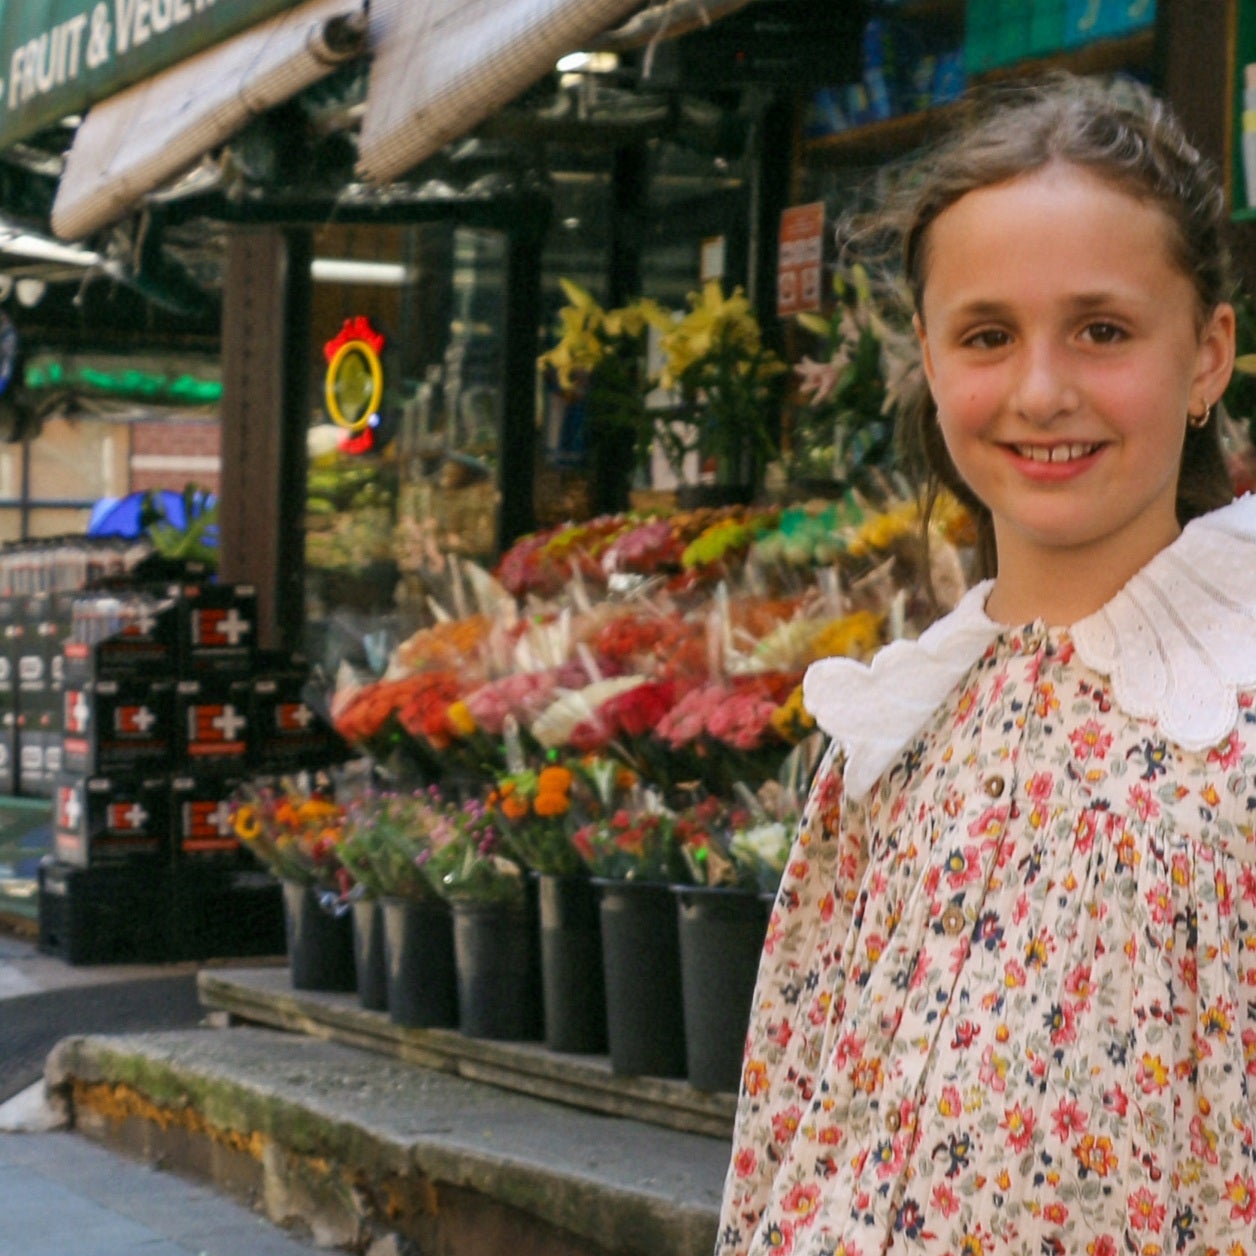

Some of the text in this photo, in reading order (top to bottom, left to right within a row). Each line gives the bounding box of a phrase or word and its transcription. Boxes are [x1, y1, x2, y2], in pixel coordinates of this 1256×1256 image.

[8, 0, 215, 110] FRUIT & VEG
